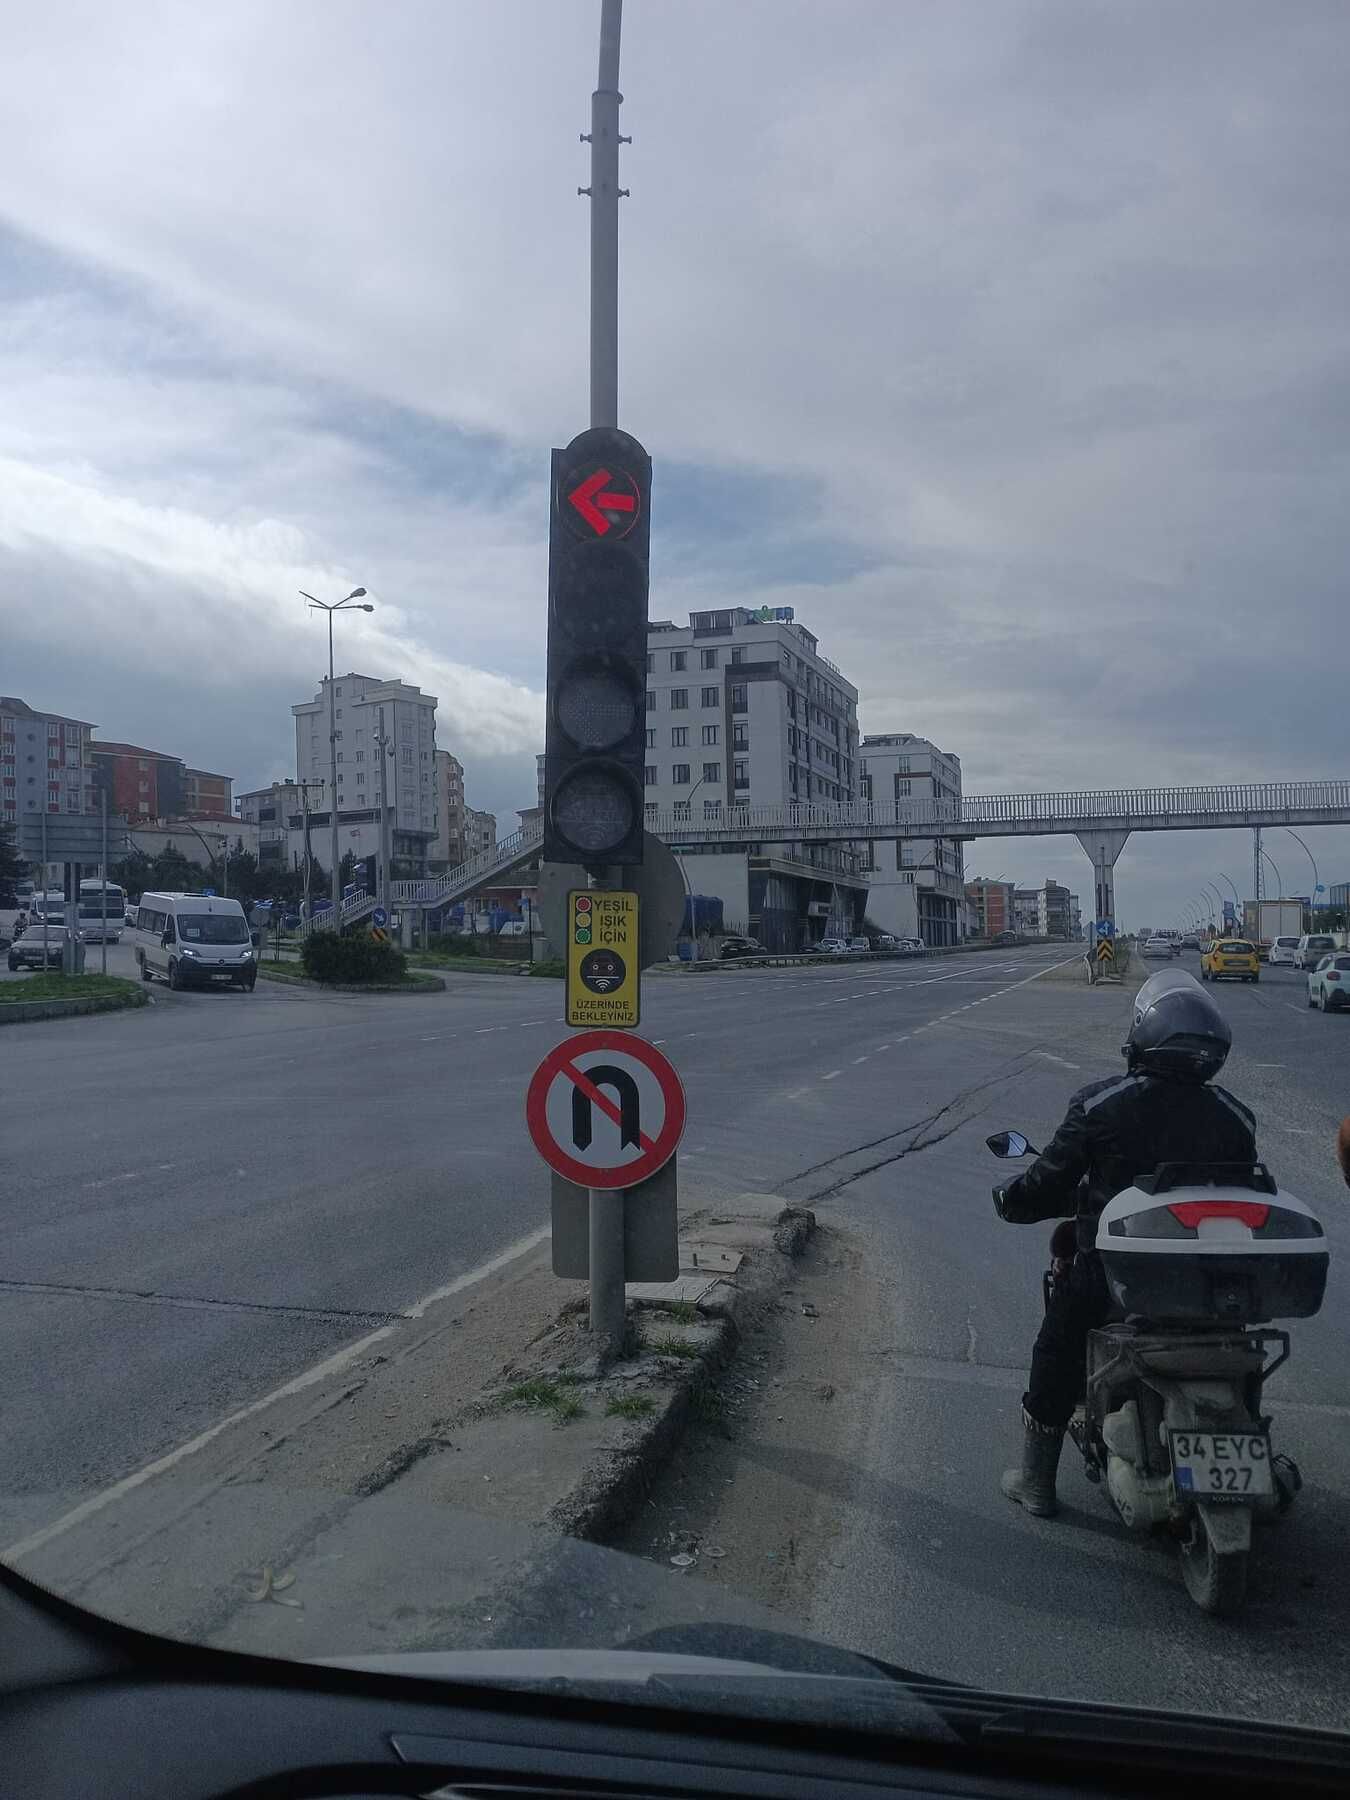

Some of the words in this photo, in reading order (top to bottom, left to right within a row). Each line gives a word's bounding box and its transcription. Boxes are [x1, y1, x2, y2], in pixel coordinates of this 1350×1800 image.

[594, 897, 633, 913] YEŞİL
[600, 915, 626, 928] IŞIK
[600, 928, 626, 944] İÇİN
[576, 999, 629, 1009] ÜZERİNDE
[572, 1011, 634, 1021] BEKLEYİNİZ
[1177, 1436, 1206, 1459] 34
[1213, 1437, 1265, 1460] EYC
[1209, 1467, 1252, 1490] 327
